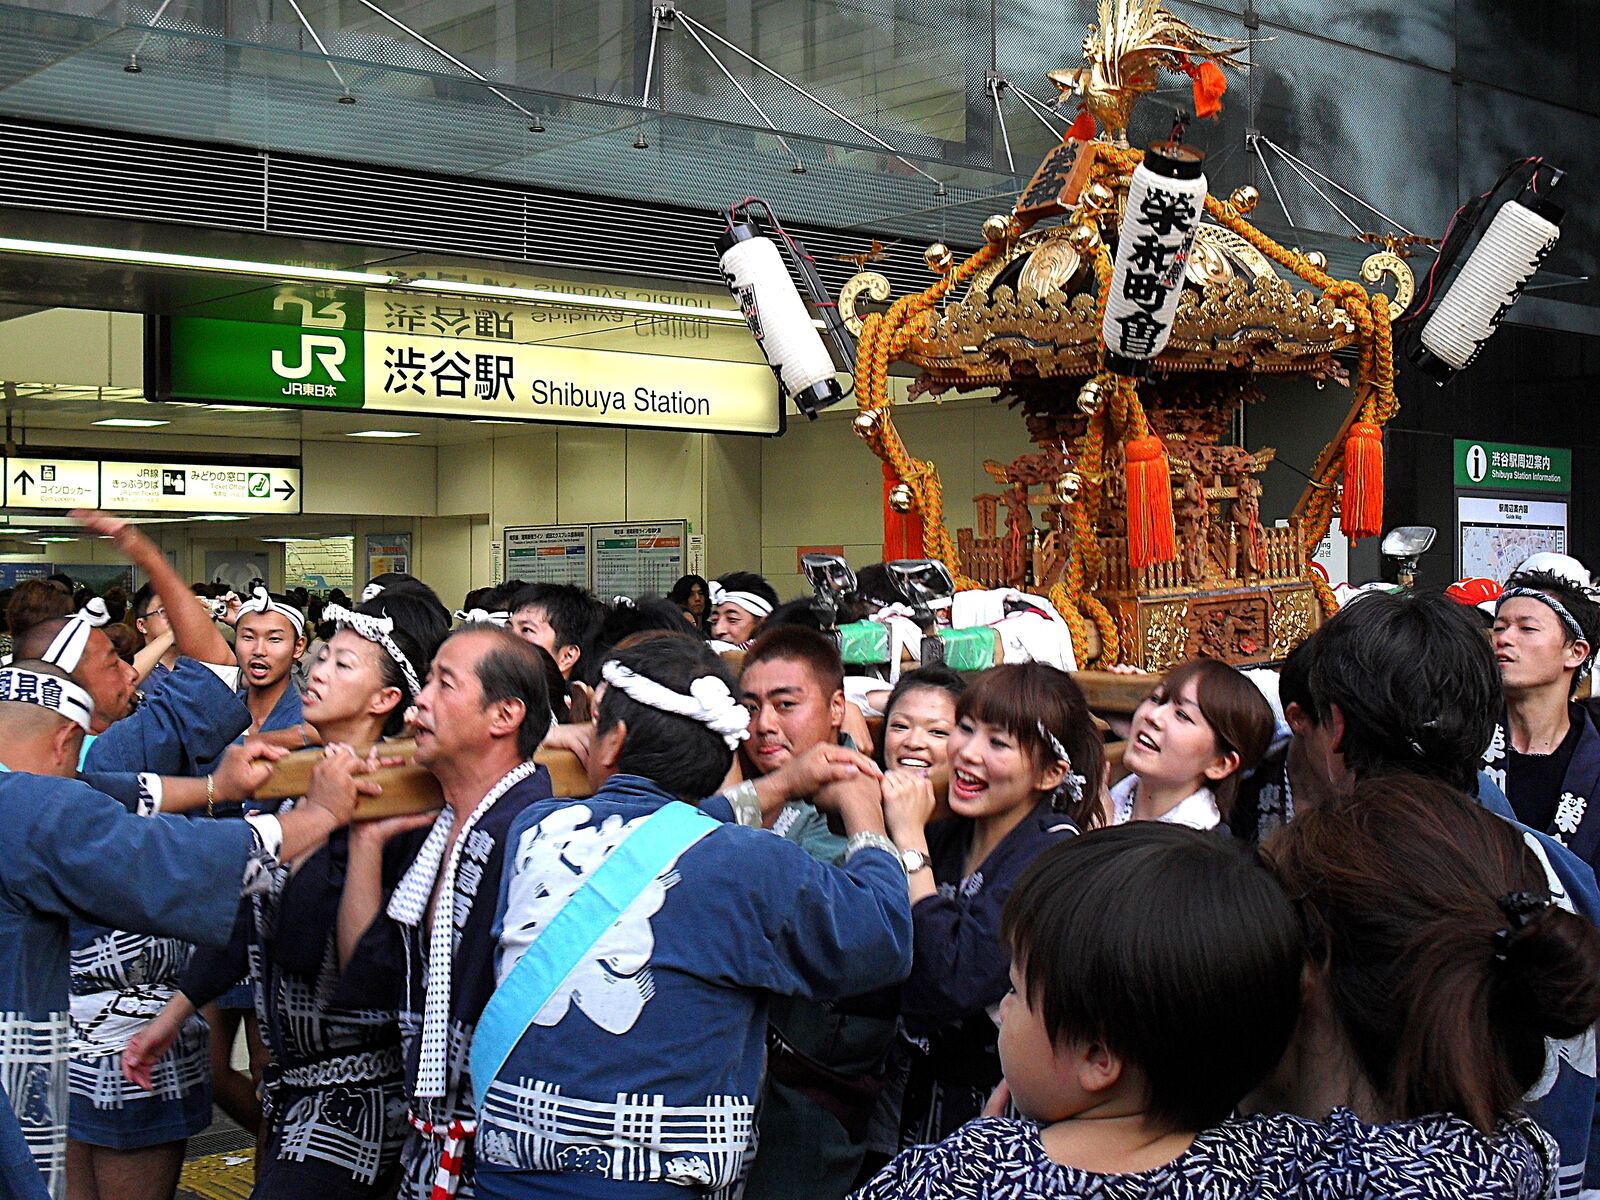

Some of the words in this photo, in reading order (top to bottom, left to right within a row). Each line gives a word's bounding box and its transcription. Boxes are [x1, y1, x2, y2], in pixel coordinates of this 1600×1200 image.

[271, 334, 346, 382] JR
[384, 346, 515, 402] 渋谷駅
[282, 382, 337, 398] JR東日本
[531, 379, 626, 415] Shibuya
[634, 387, 711, 416] Station
[1491, 452, 1551, 471] 渋谷駅周辺案内
[137, 468, 159, 478] JR線
[190, 470, 246, 482] みどりの窓口
[1491, 470, 1513, 481] Shibuya
[1513, 471, 1532, 481] Station
[1532, 473, 1561, 483] Information
[40, 485, 92, 495] コインロッカー
